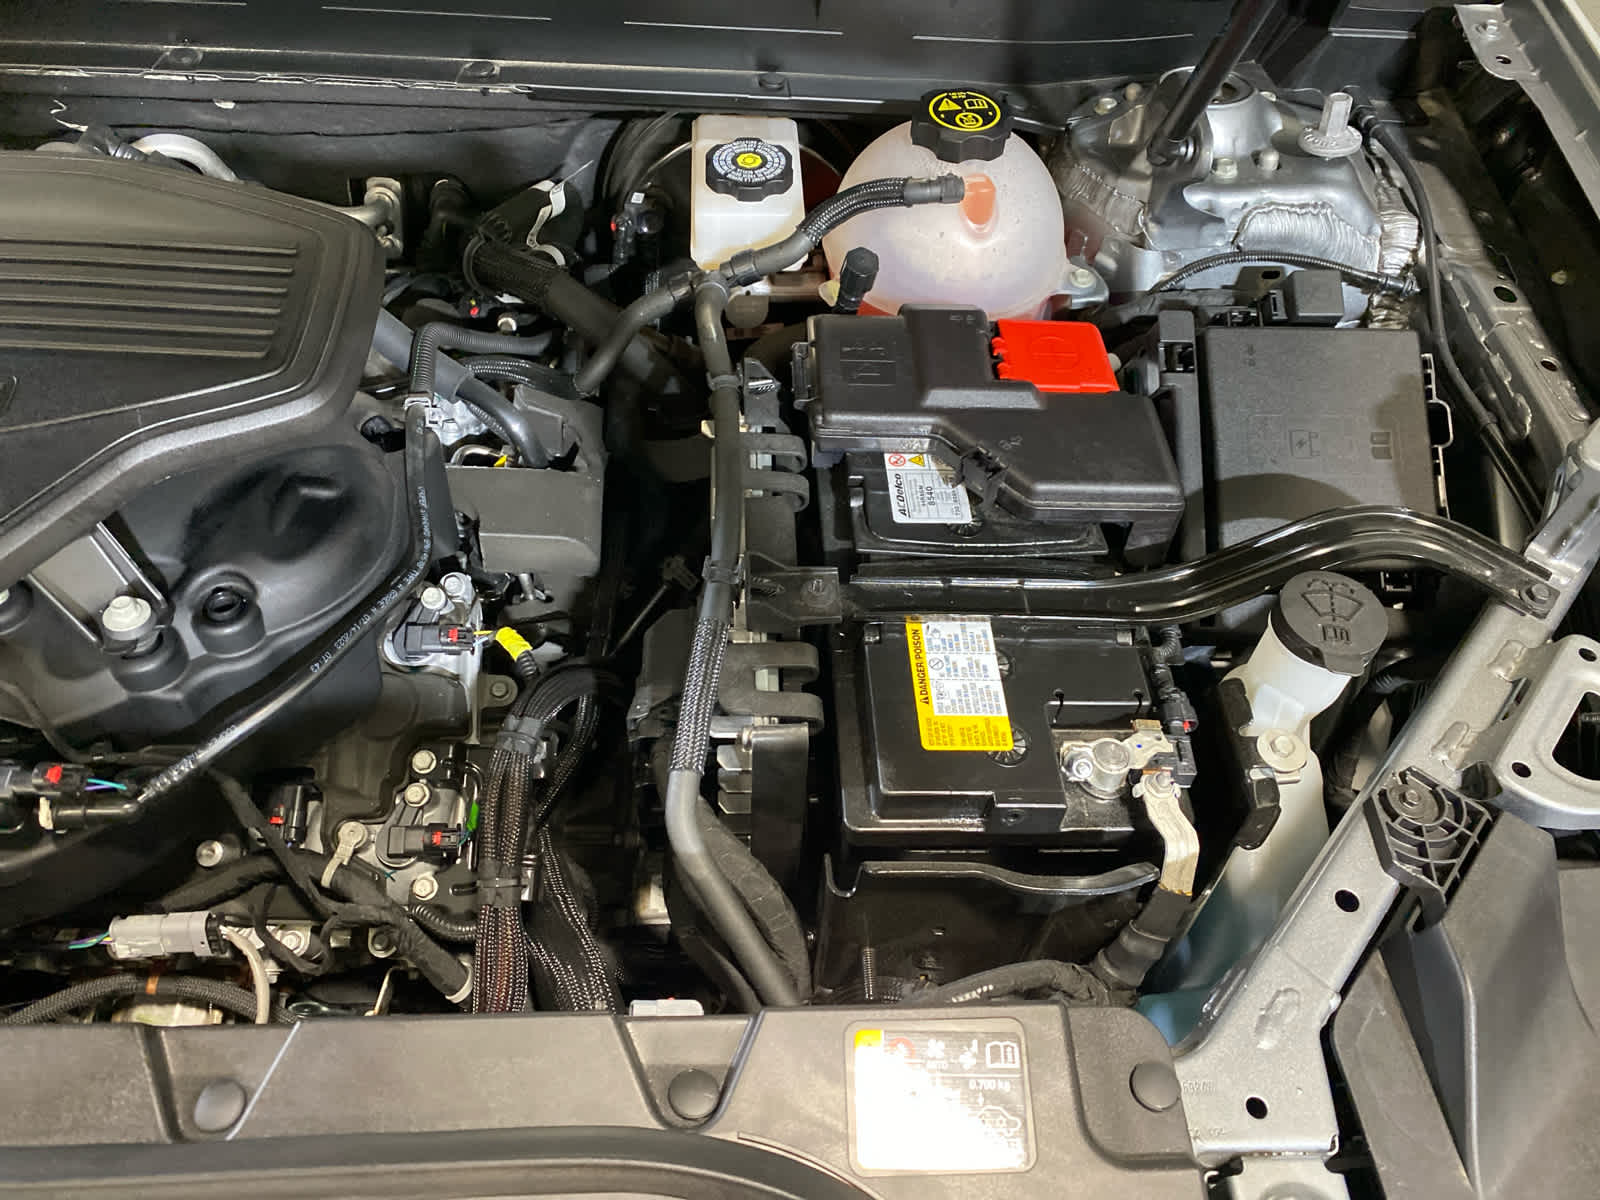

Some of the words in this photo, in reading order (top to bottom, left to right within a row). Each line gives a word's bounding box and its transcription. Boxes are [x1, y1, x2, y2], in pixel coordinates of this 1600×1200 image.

[925, 486, 936, 506] 8540
[912, 629, 923, 660] POISON
[916, 662, 929, 696] DANGER
